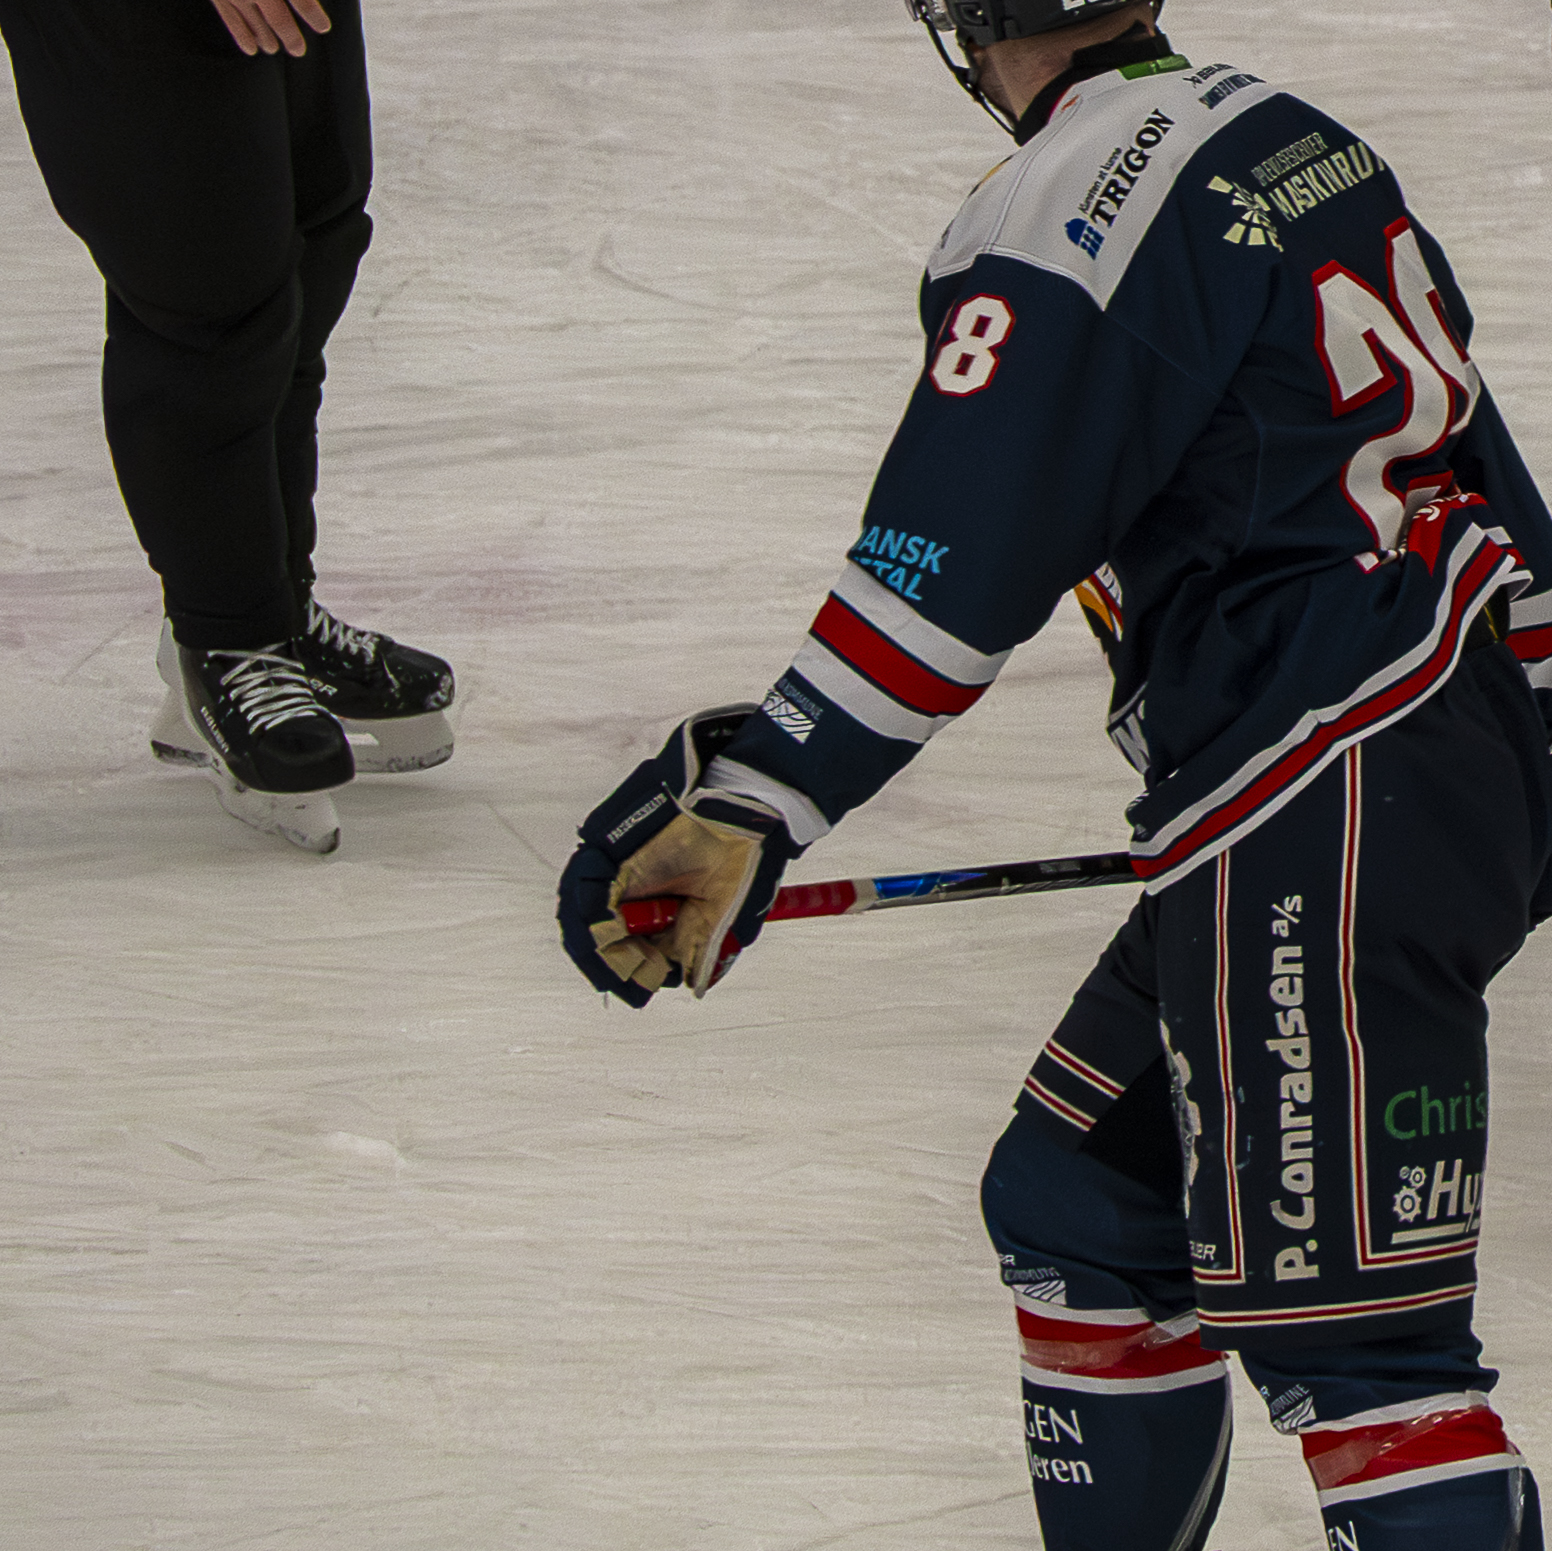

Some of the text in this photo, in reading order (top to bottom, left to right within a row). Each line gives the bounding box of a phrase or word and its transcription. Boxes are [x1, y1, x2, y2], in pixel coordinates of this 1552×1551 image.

[1090, 107, 1176, 227] TRIGON
[1267, 140, 1387, 223] MASKINRU
[929, 292, 1017, 397] 8
[850, 525, 950, 575] ANSK
[852, 555, 924, 602] TAL
[1266, 894, 1320, 1282] P. Conradsen a/s
